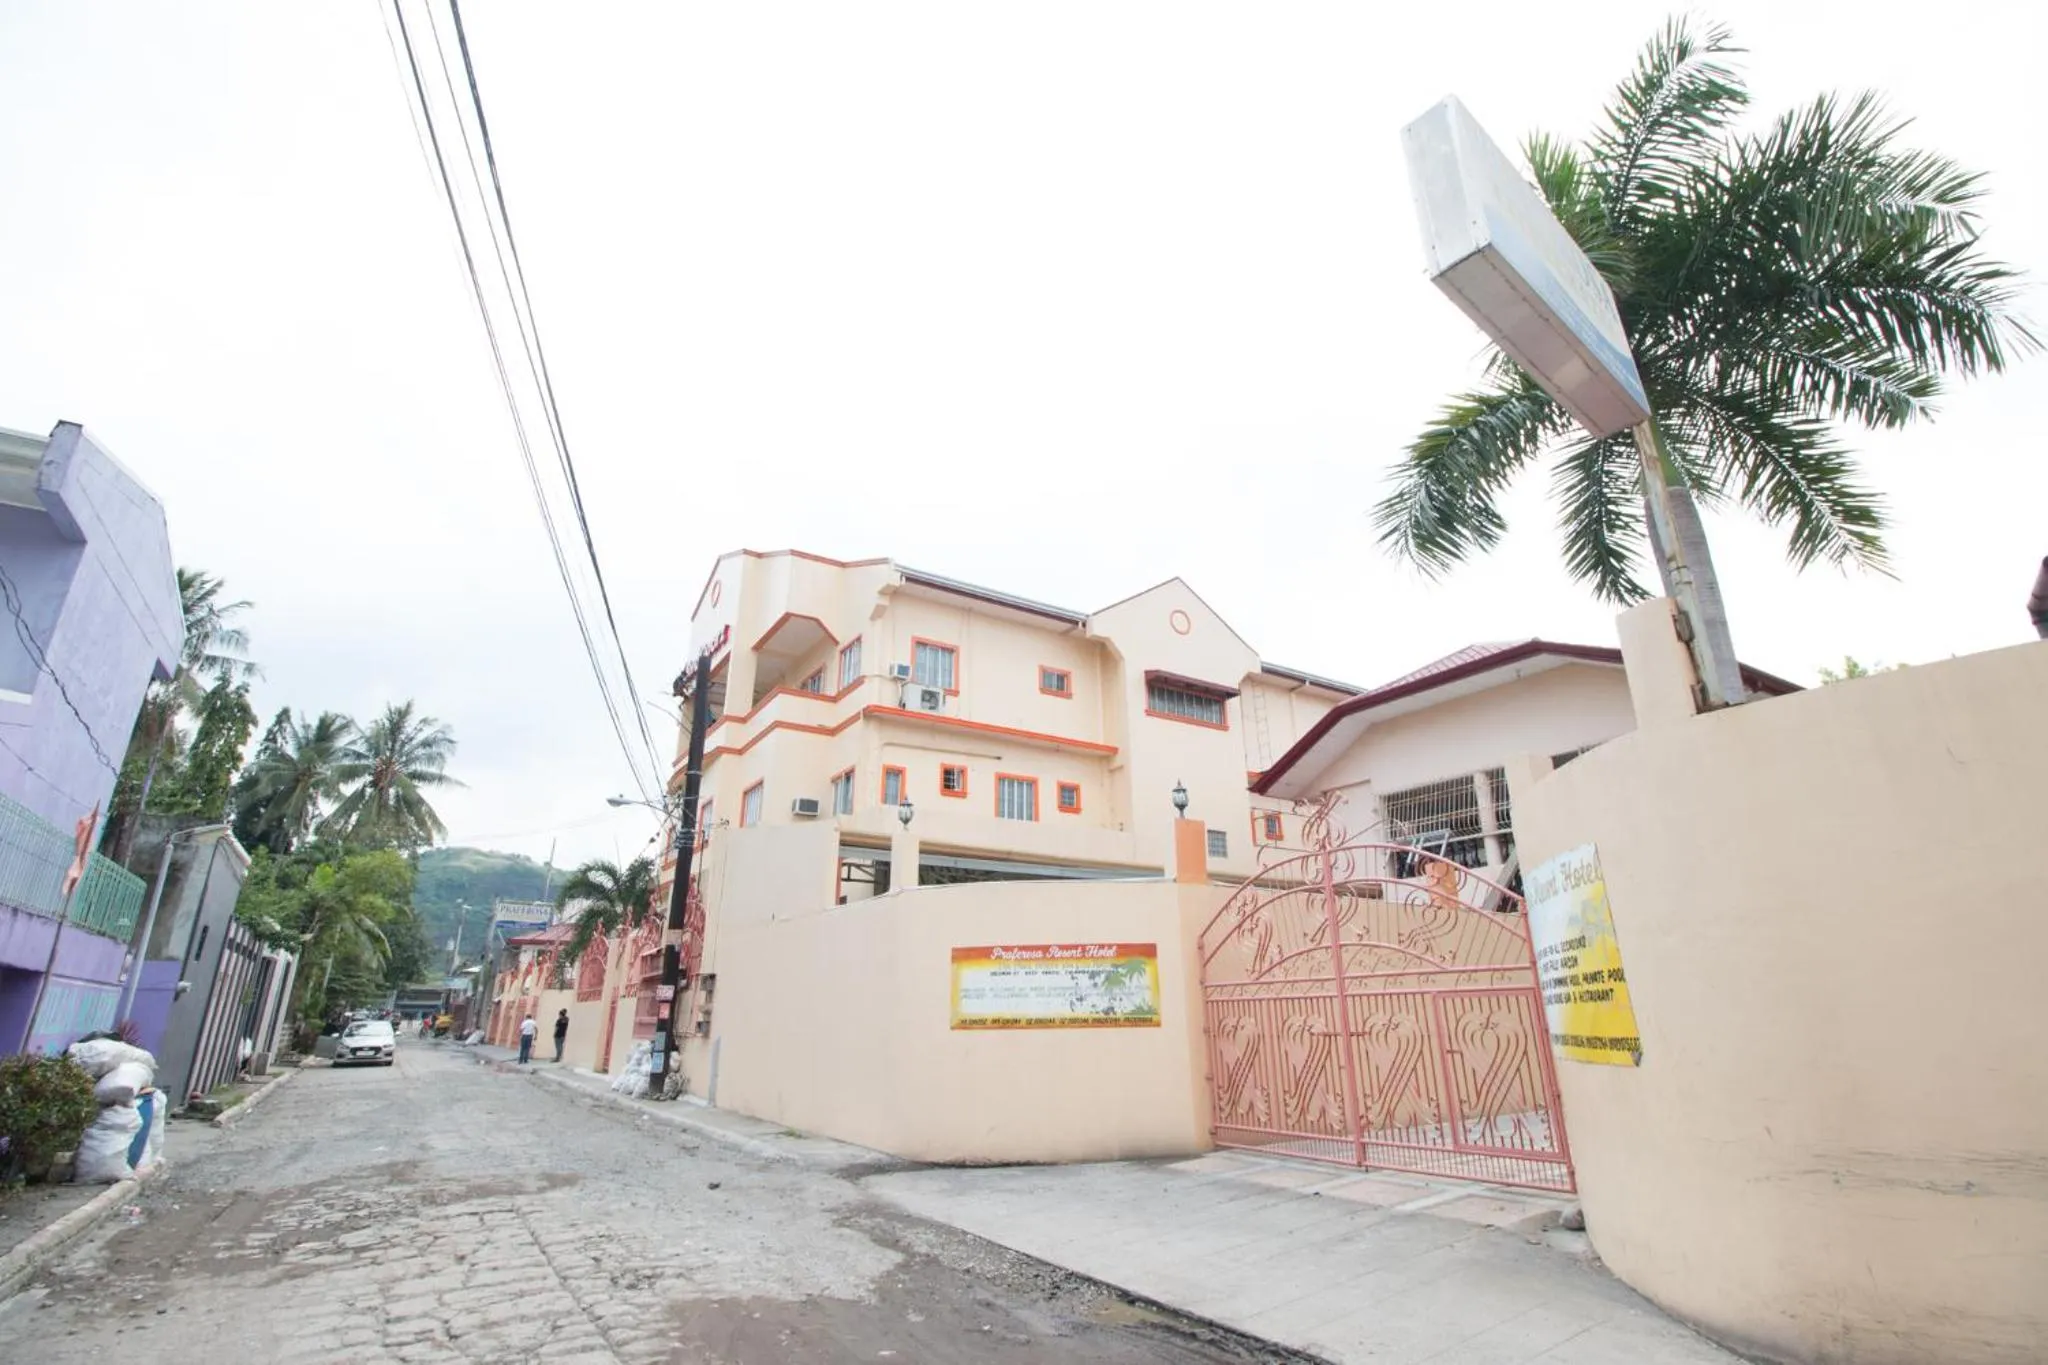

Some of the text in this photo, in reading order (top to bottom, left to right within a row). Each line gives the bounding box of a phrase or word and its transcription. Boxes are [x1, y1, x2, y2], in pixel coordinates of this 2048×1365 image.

[1560, 853, 1604, 892] Hotel
[1046, 944, 1082, 958] Resort
[1085, 944, 1117, 957] Hotel
[1607, 967, 1626, 983] POOL
